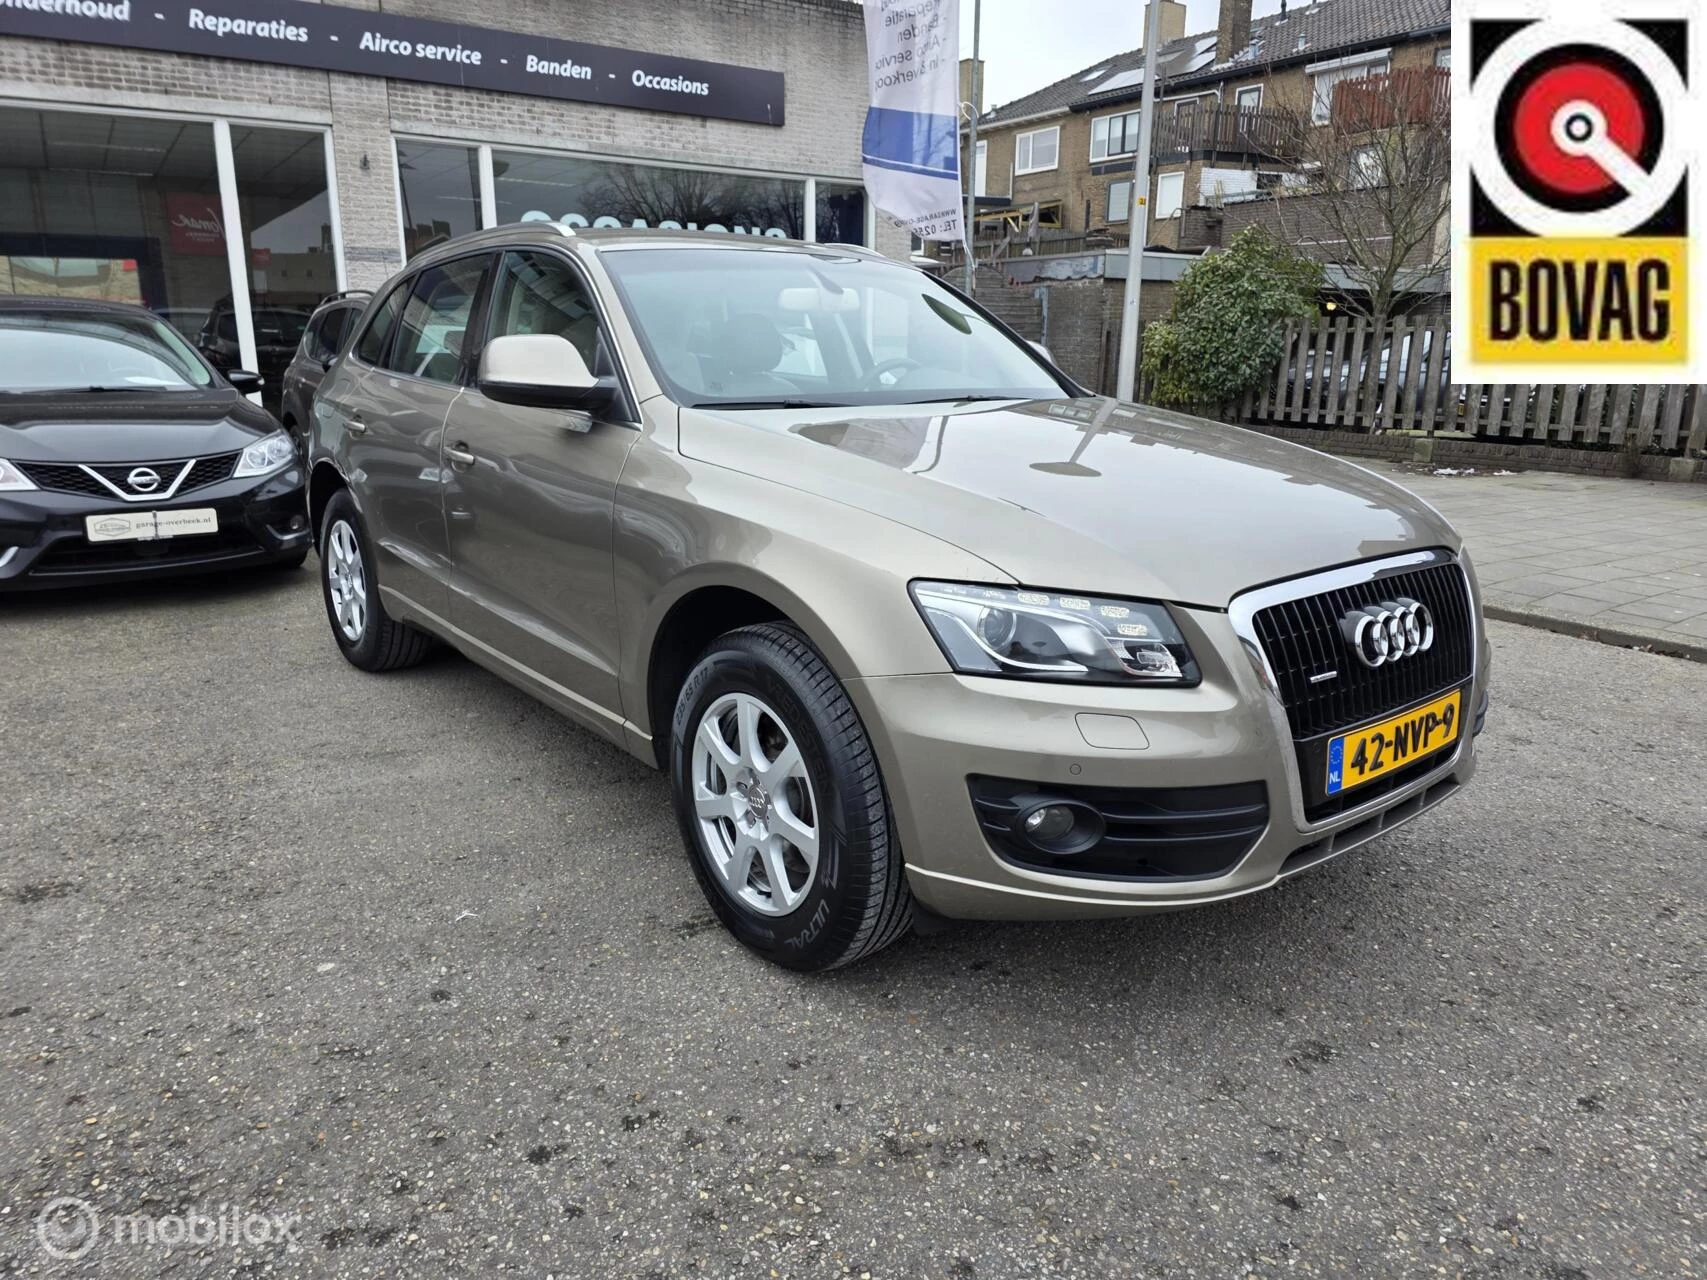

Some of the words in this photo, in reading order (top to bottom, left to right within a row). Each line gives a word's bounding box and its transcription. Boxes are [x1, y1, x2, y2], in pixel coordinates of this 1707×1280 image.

[0, 0, 131, 21] erhoud
[188, 8, 309, 42] Reparaties
[359, 31, 413, 56] Airco
[415, 43, 482, 65] service
[526, 54, 592, 81] Banden
[631, 69, 710, 96] Occasions
[1350, 702, 1456, 776] 42-NVP-9
[1329, 771, 1341, 784] NL
